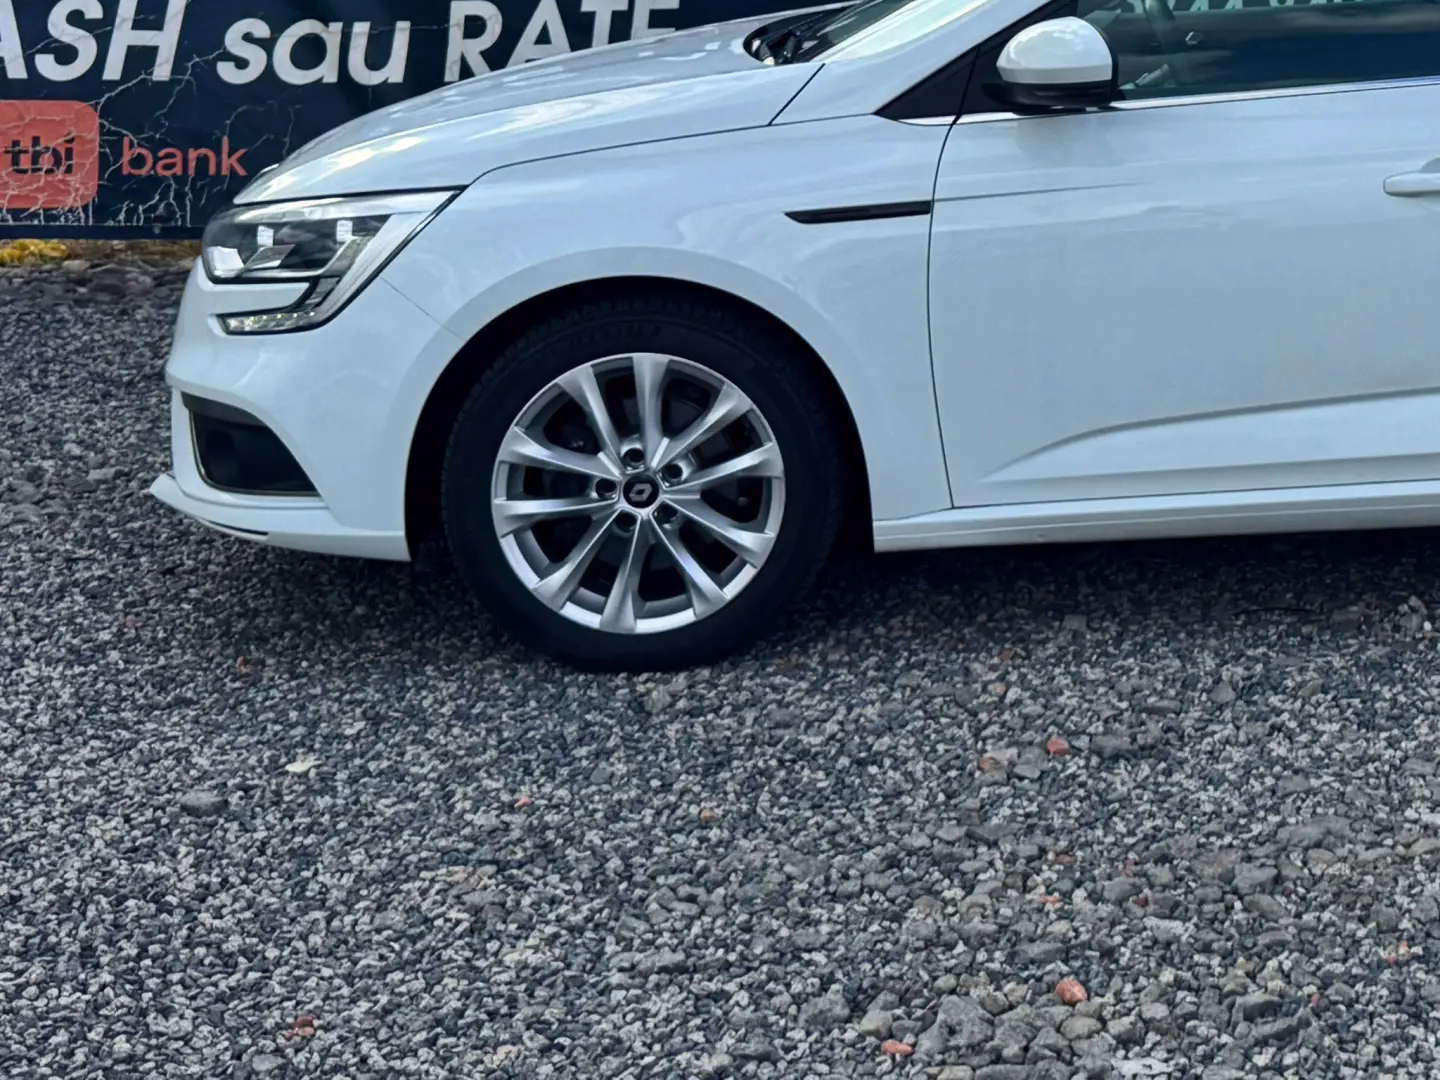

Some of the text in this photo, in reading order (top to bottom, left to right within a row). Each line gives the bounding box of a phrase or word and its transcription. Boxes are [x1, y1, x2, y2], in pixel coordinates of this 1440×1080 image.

[216, 18, 411, 86] sau
[4, 135, 249, 176] tbi bank
